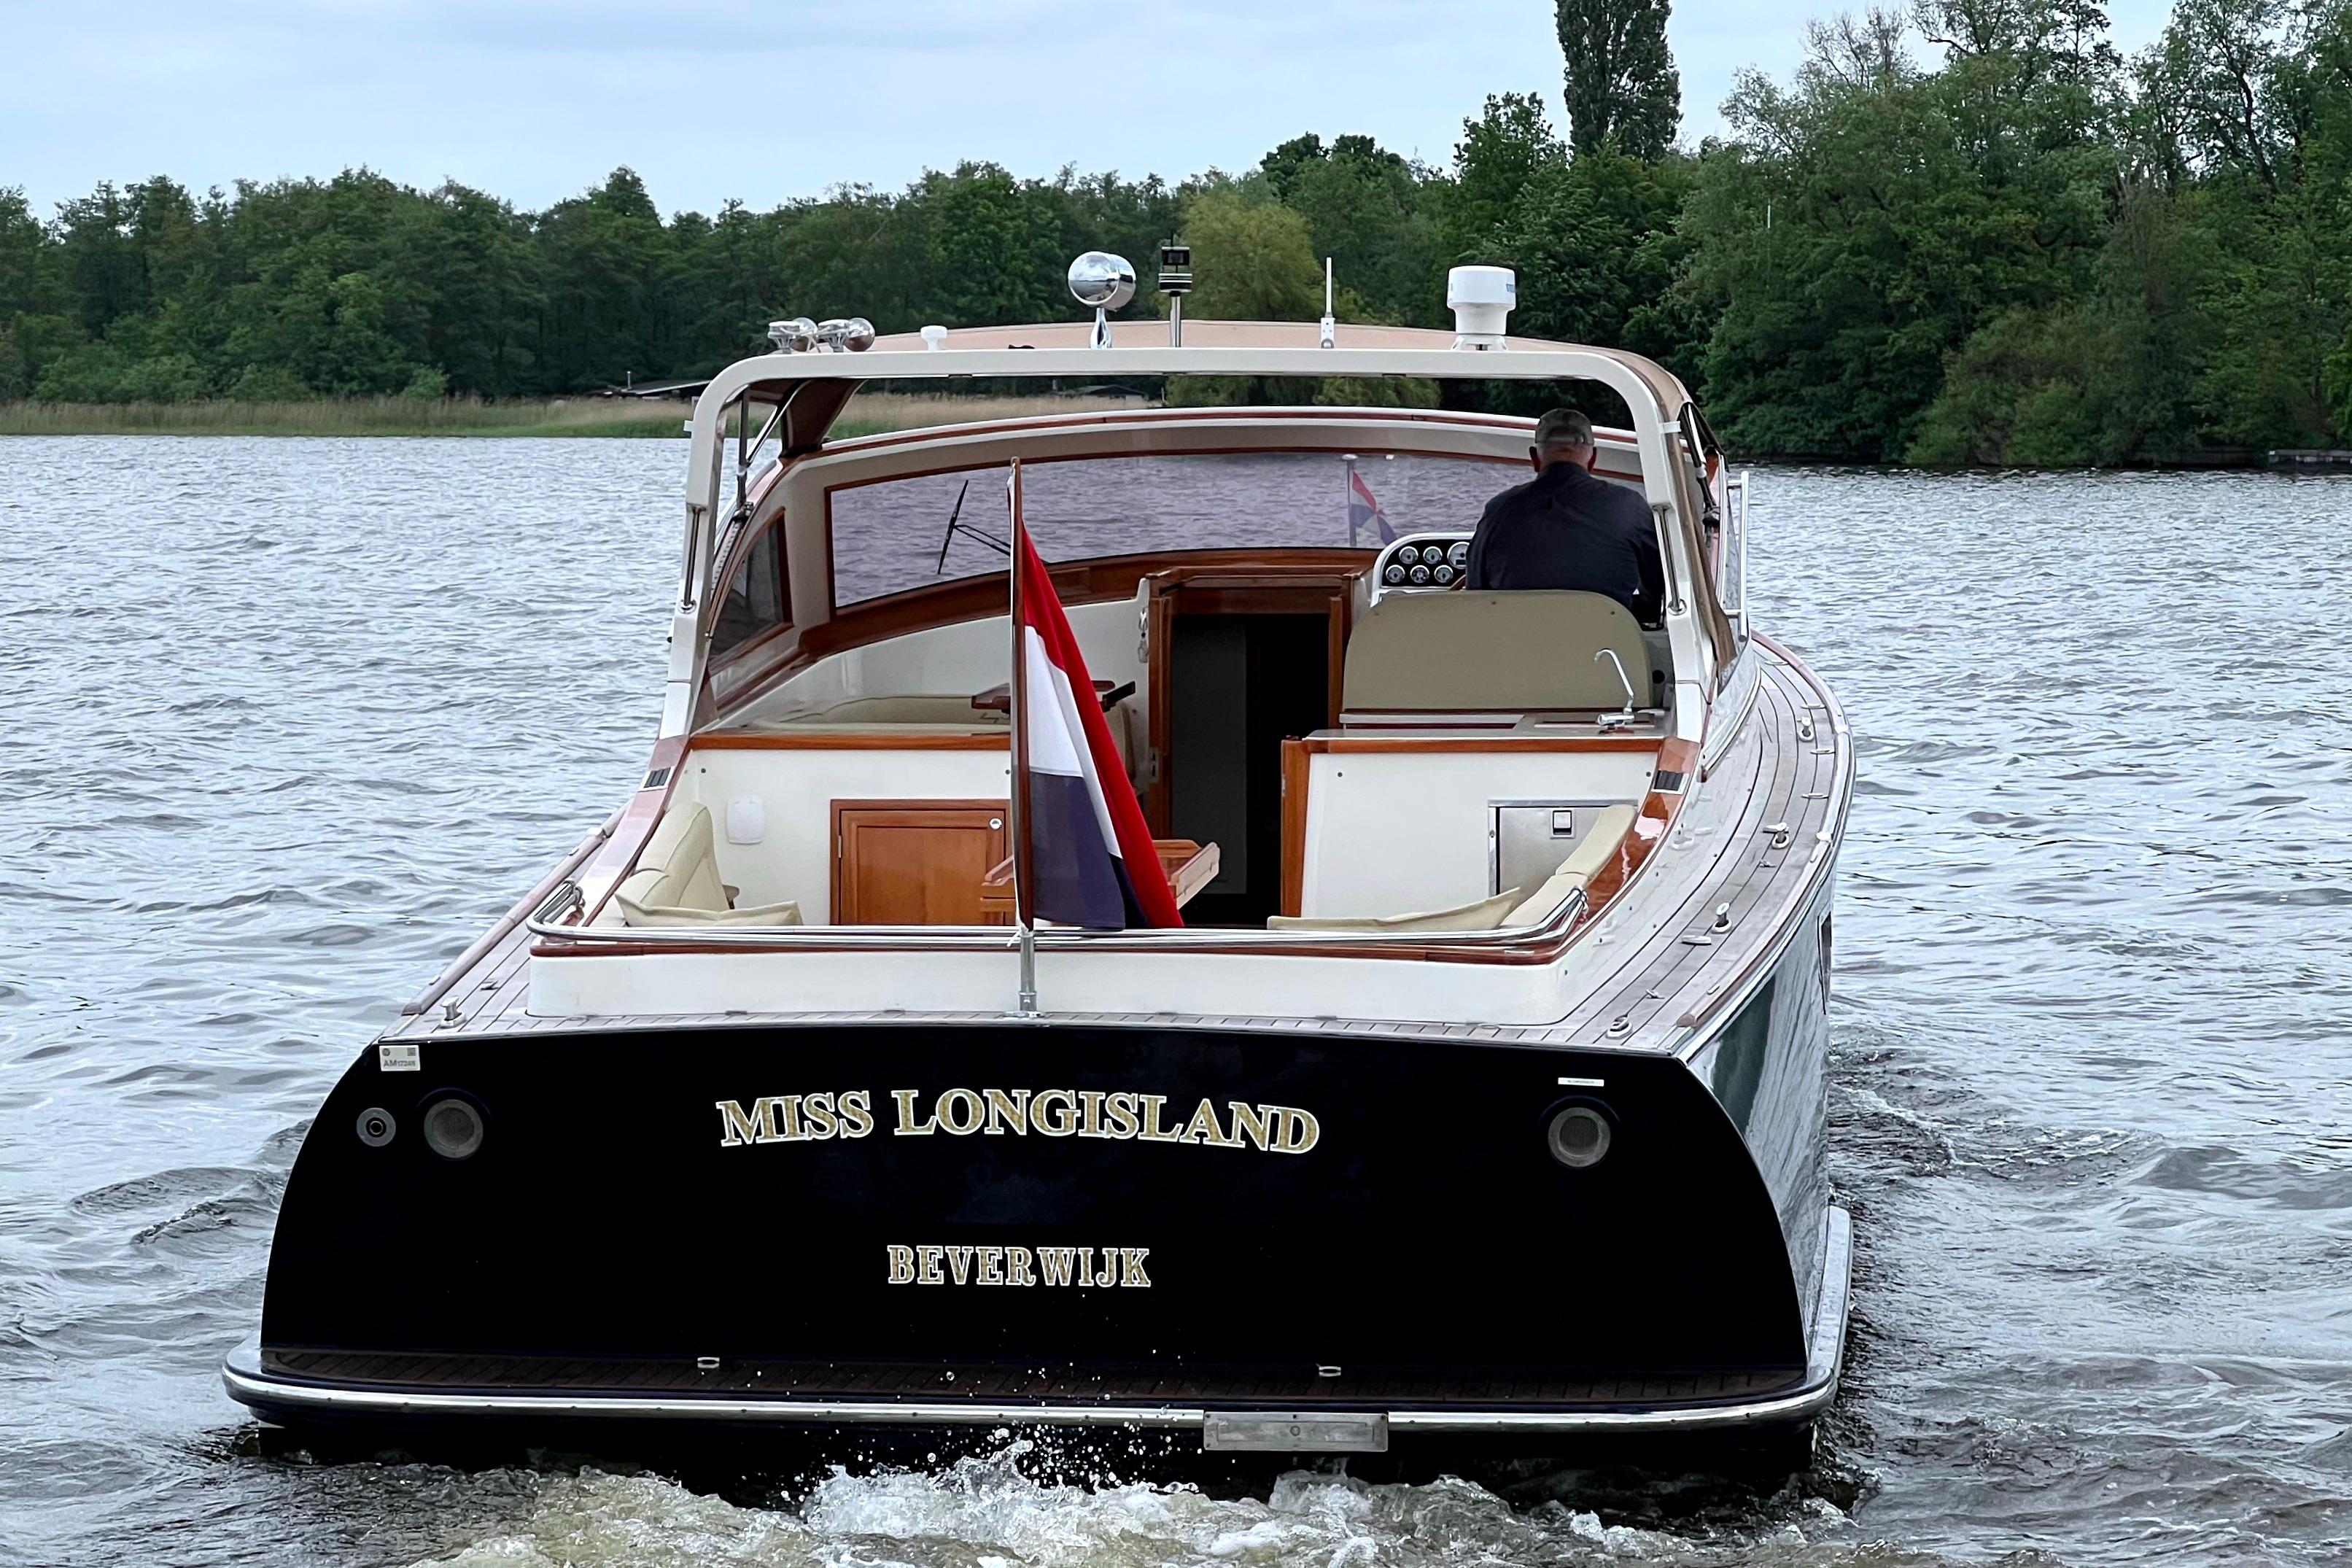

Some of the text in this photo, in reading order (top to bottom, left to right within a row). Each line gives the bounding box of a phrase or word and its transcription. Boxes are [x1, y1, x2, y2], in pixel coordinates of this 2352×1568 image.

[715, 1088, 1320, 1154] MISS LONGISLAND
[887, 1245, 1151, 1287] BEVERWIJK
